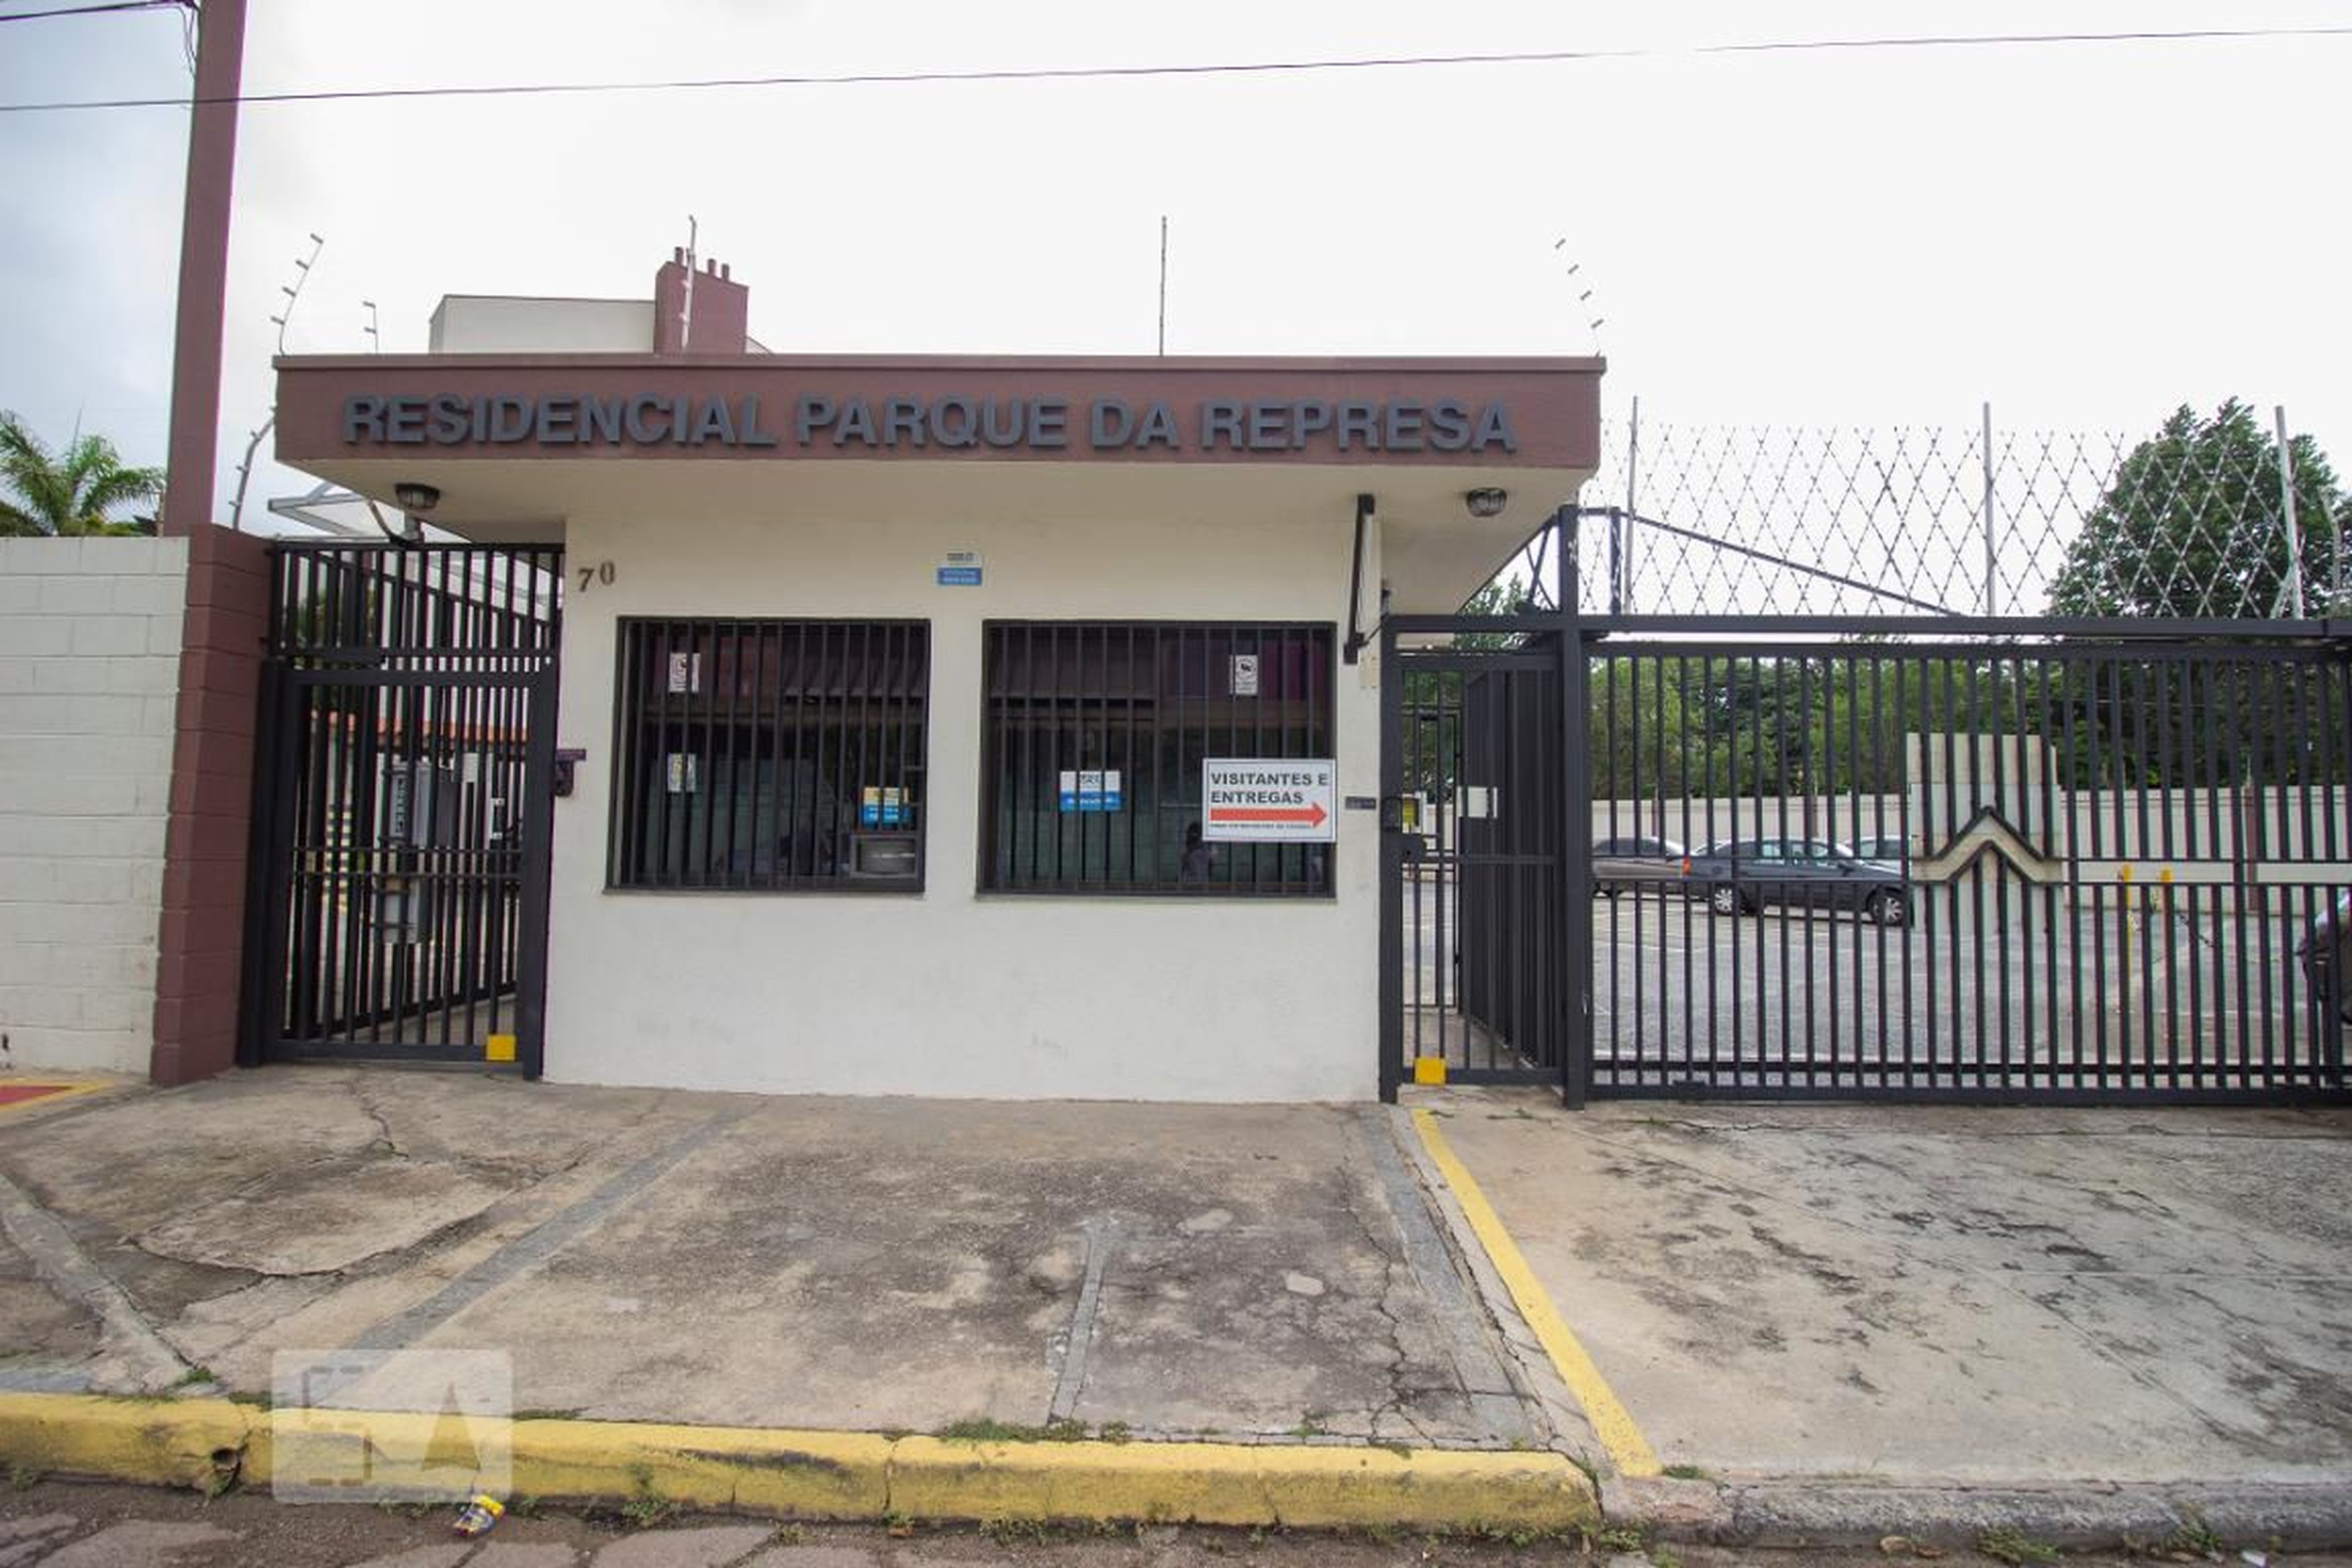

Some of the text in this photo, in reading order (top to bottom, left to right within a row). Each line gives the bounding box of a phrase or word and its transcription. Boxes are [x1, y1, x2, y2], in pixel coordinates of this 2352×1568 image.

[342, 393, 1517, 451] RESIDENCIAL PARQUE DA REPRESA
[578, 560, 616, 593] 70
[1210, 772, 1329, 786] VISITANTES E
[1211, 790, 1304, 804] ENTREGAS
